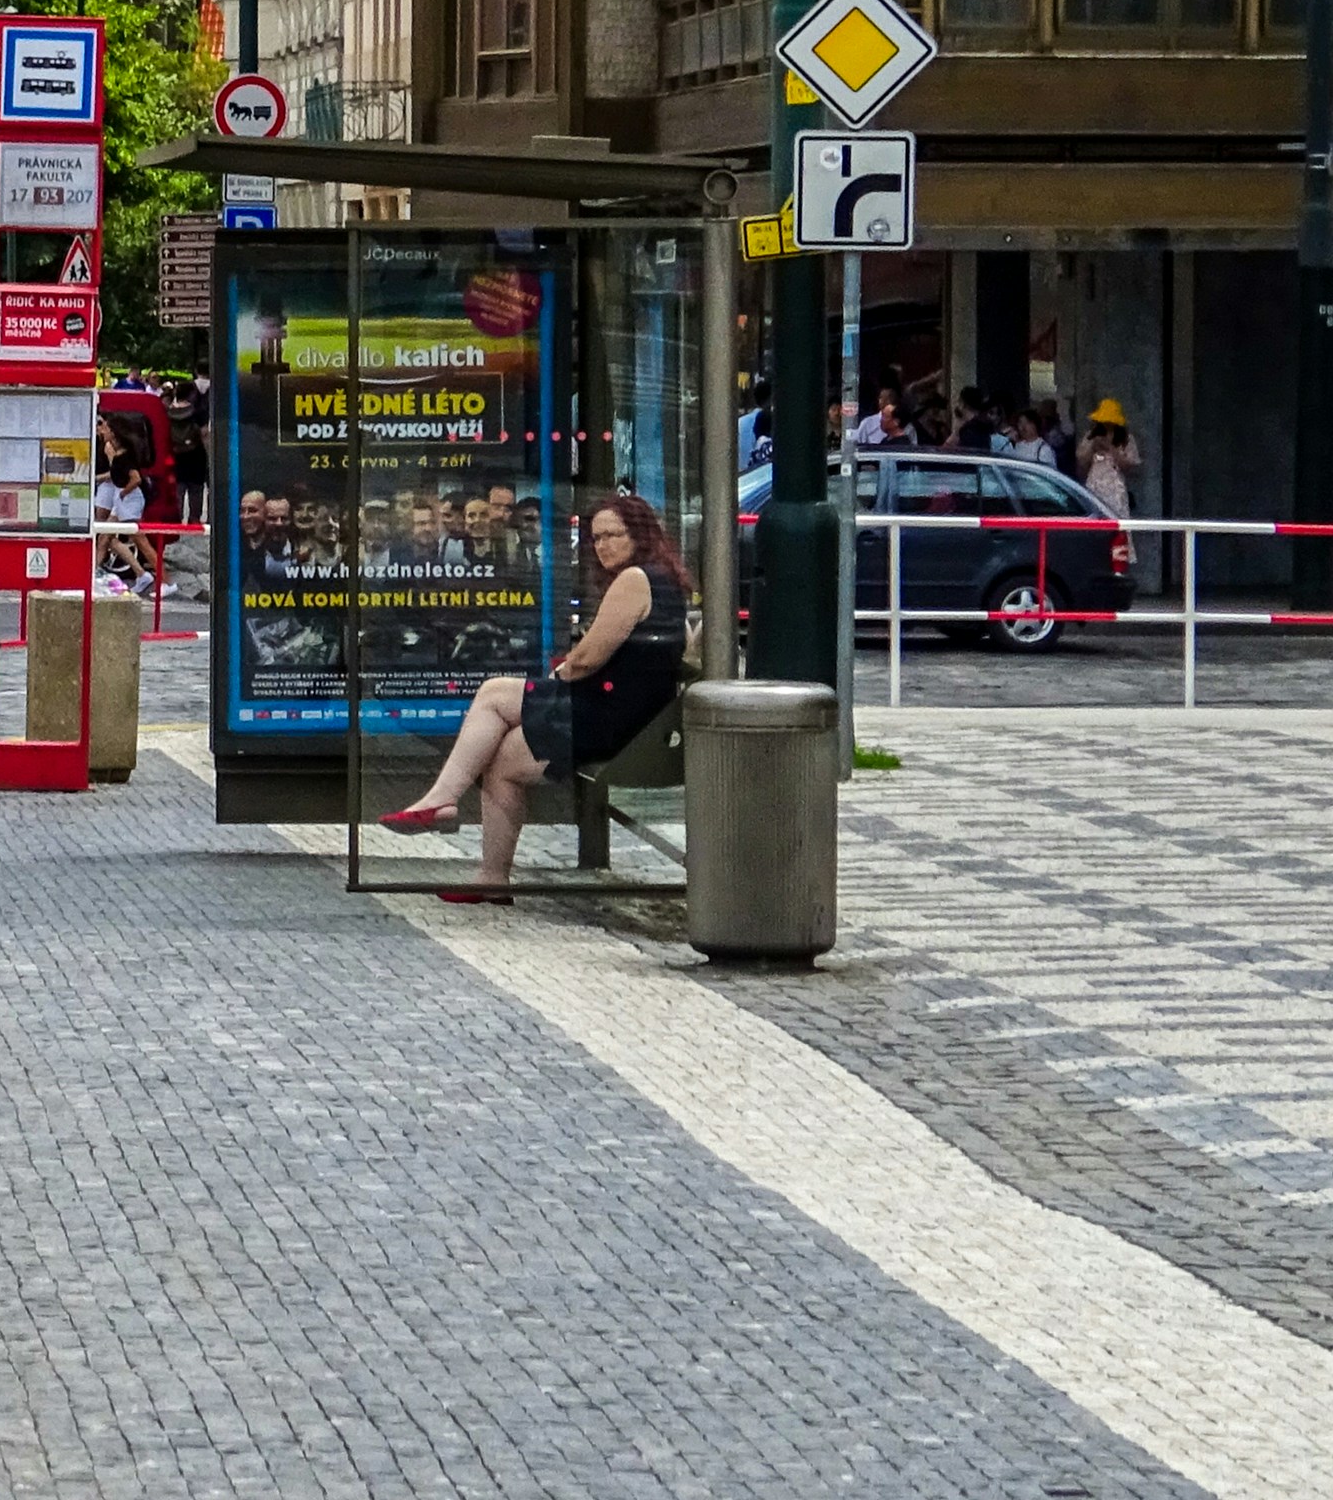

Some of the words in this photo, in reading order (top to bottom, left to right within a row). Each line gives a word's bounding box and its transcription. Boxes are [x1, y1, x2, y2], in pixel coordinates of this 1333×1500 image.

[18, 156, 82, 169] PRÁVNICKÁ
[26, 170, 73, 182] FAKULTA
[11, 188, 28, 202] 17
[40, 188, 58, 203] 93
[66, 190, 93, 203] 207
[363, 247, 442, 262] JCDecaux
[58, 298, 86, 309] MHD
[296, 346, 385, 368] divalo
[394, 344, 485, 368] kalich
[295, 388, 417, 417] HVĚDNÉ
[421, 388, 486, 417] LÉTO
[297, 423, 335, 439] POD
[337, 419, 443, 440] ŽOVSKOU
[309, 454, 335, 469] 23.
[341, 454, 399, 469] črvna
[244, 590, 297, 608] NOVÁ
[419, 589, 470, 607] LETNÍ
[475, 588, 535, 607] SCÉNA
